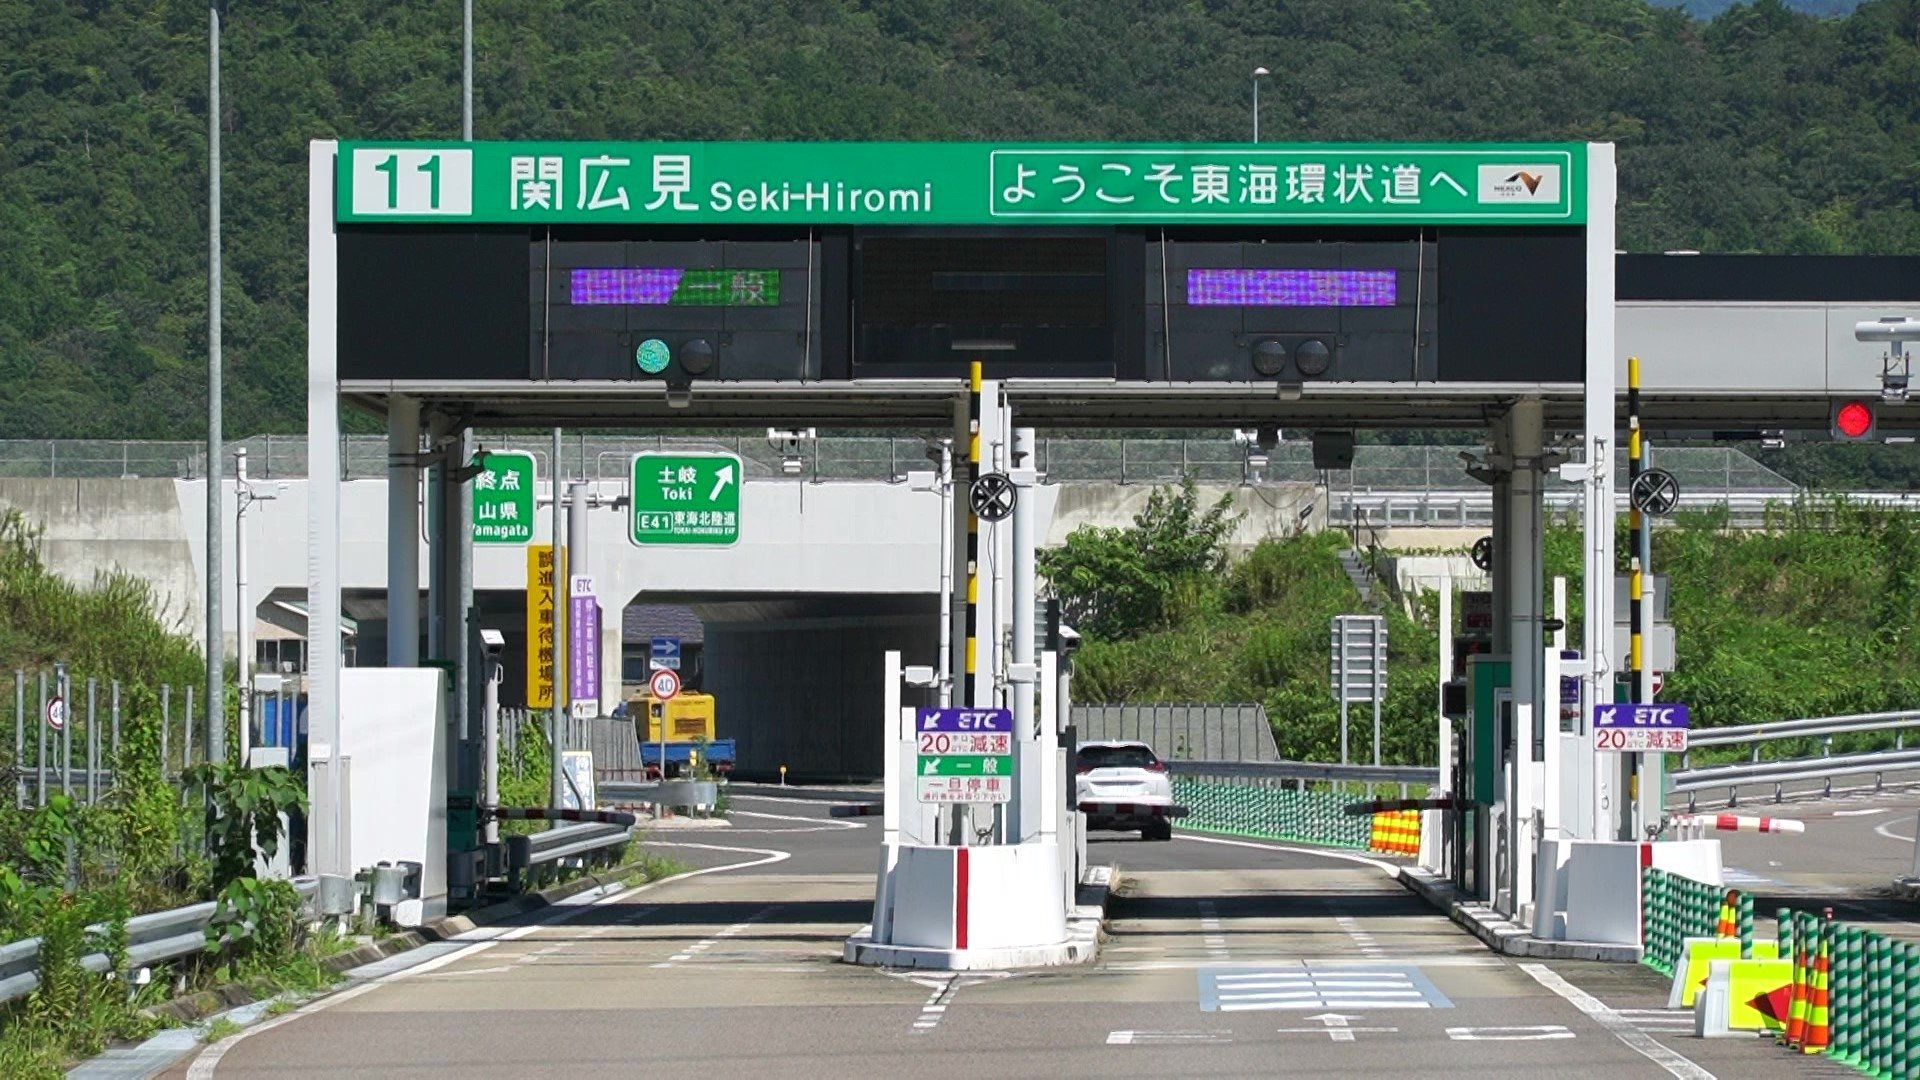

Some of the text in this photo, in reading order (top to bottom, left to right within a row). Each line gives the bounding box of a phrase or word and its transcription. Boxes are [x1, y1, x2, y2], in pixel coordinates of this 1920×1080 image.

[374, 154, 441, 210] 11
[510, 155, 700, 211] 関広見
[1002, 162, 1469, 205] ようこそ東海環状道へ
[709, 181, 933, 213] Seki-Hiromi
[657, 465, 697, 485] 土岐
[661, 486, 693, 500] Toki
[479, 501, 518, 520] 山県
[673, 511, 736, 527] 東海北陸道
[640, 514, 670, 528] E41
[576, 578, 592, 592] ETC
[657, 678, 673, 692] 40
[958, 712, 998, 729] ETC
[1634, 707, 1675, 725] ETC
[921, 733, 1008, 753] 20 減速
[1597, 729, 1684, 748] 20 減速
[956, 757, 998, 774] 一般
